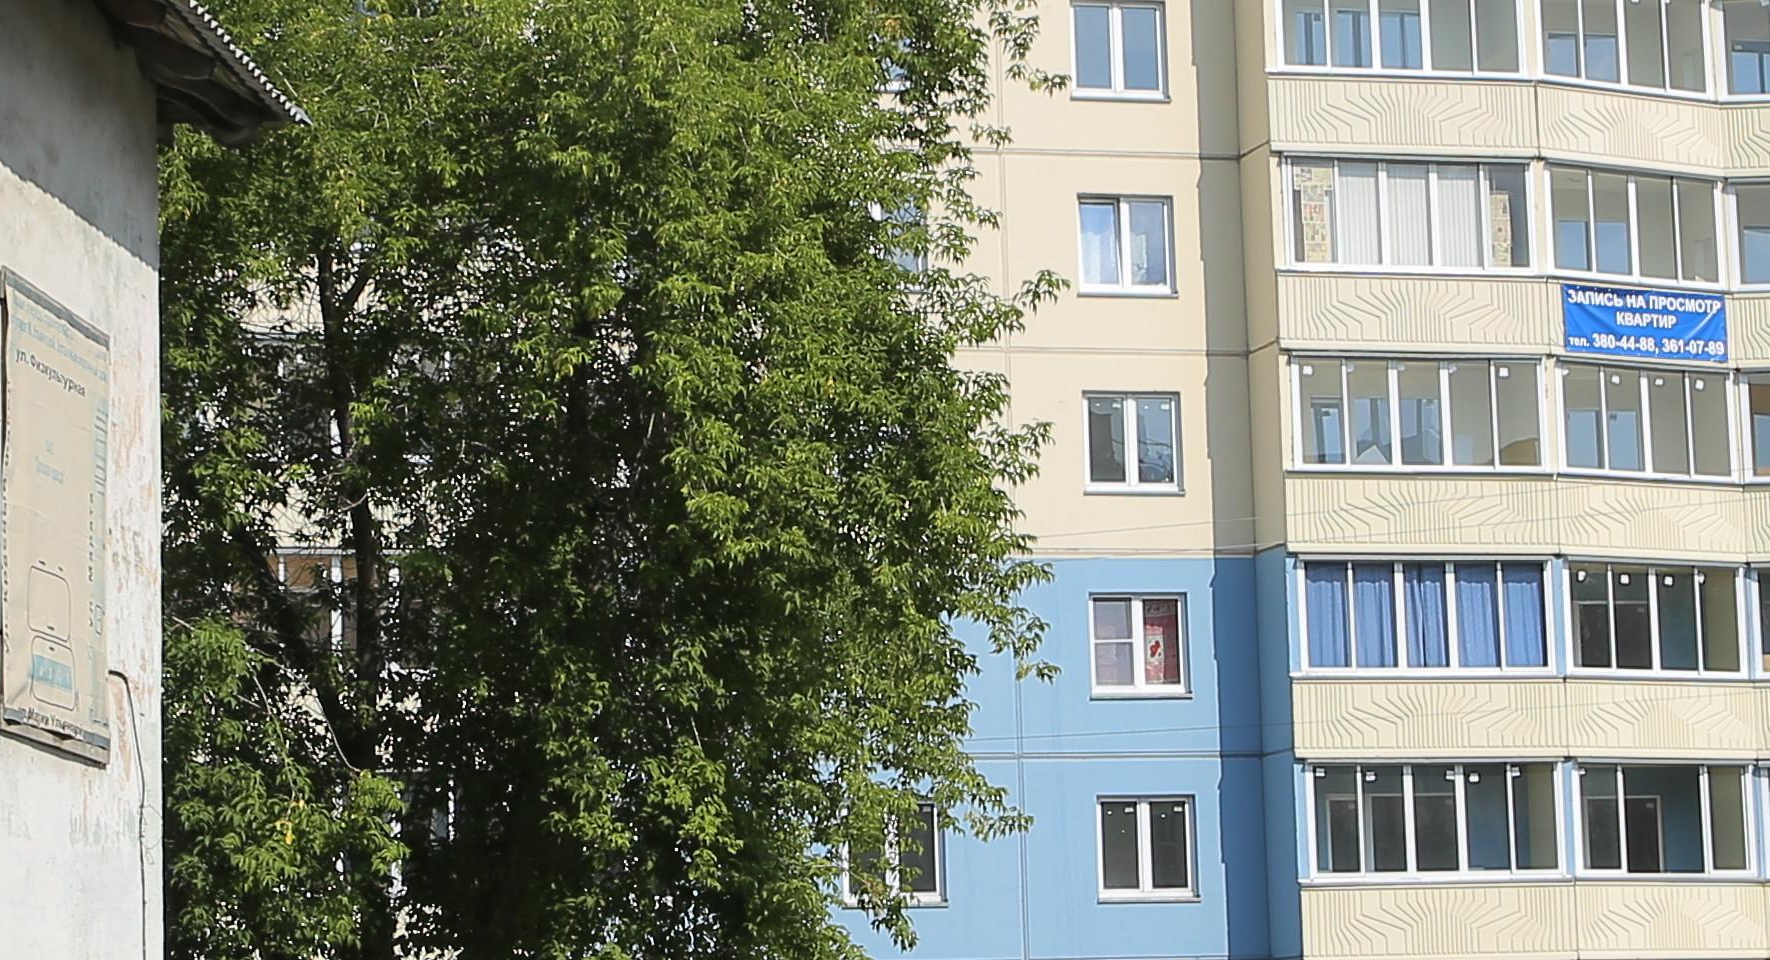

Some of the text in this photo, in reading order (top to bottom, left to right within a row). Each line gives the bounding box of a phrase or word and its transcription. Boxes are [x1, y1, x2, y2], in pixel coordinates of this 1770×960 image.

[1567, 289, 1722, 313] ЗАПИСЬ НА ПРОСМОТР
[1615, 311, 1677, 329] КВАРТИР
[1568, 333, 1725, 356] тел. 380-44-88, 361-07-89
